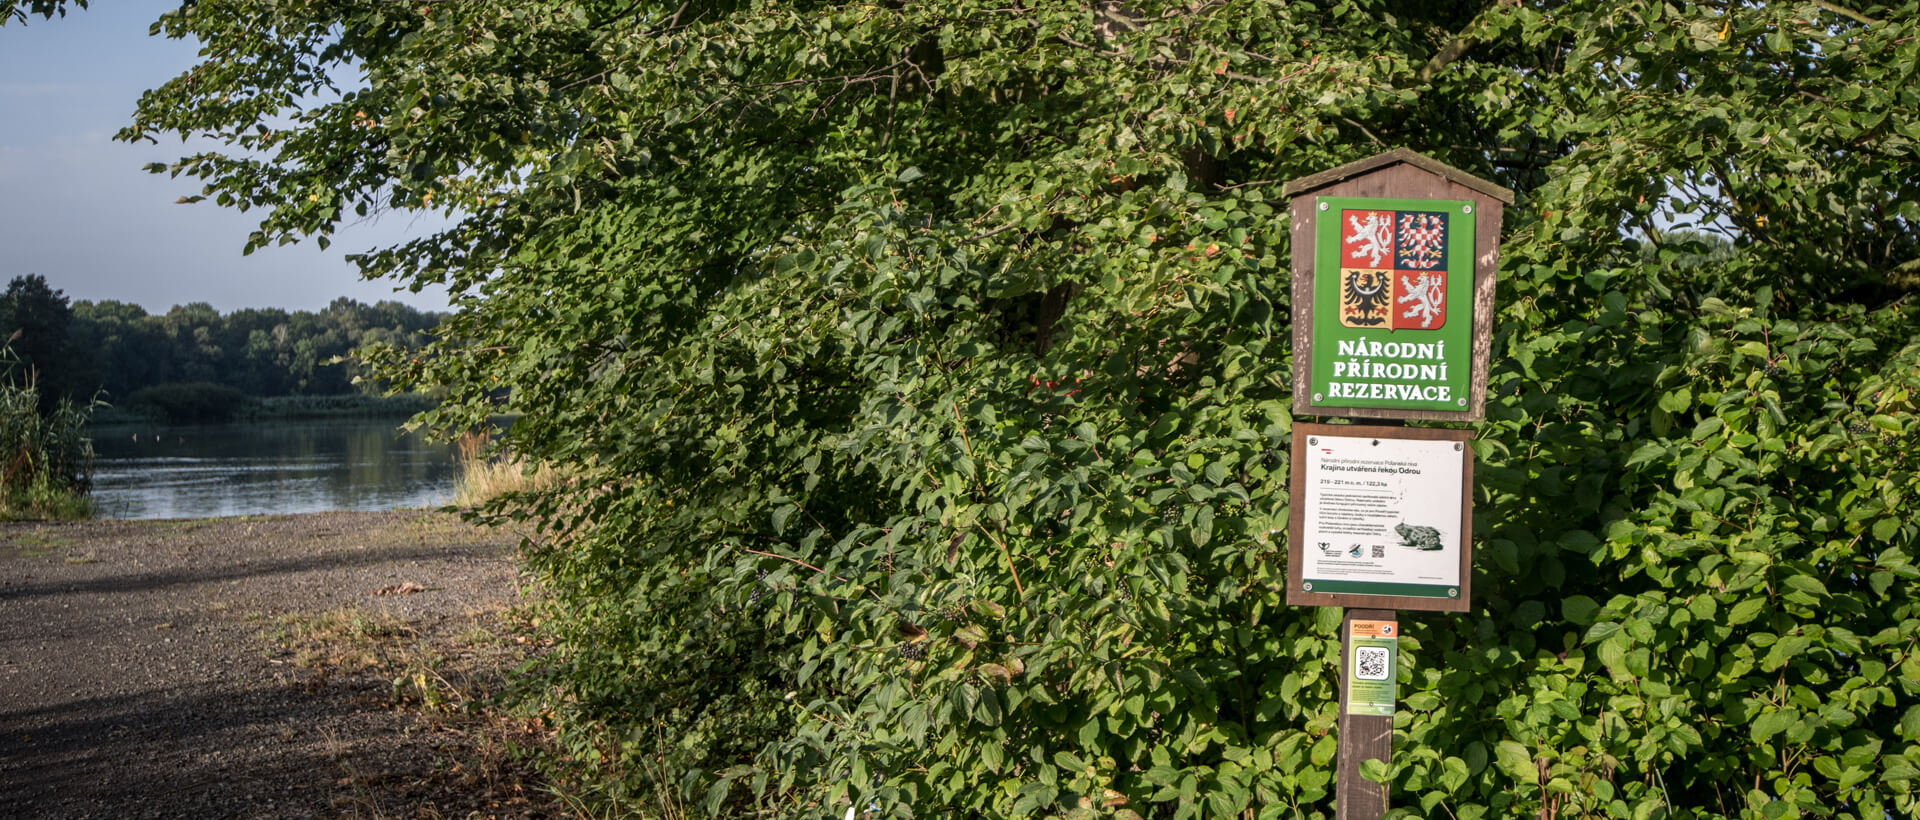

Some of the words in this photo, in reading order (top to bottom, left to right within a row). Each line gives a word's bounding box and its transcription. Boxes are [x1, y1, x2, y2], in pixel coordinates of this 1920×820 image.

[1338, 336, 1445, 360] NÁRODNÍ
[1333, 358, 1448, 381] PŘÍRODNÍ
[1328, 382, 1451, 402] REZERVACE
[1320, 463, 1345, 472] Krajina
[1346, 465, 1377, 473] utvářená
[1398, 467, 1421, 475] Odrou
